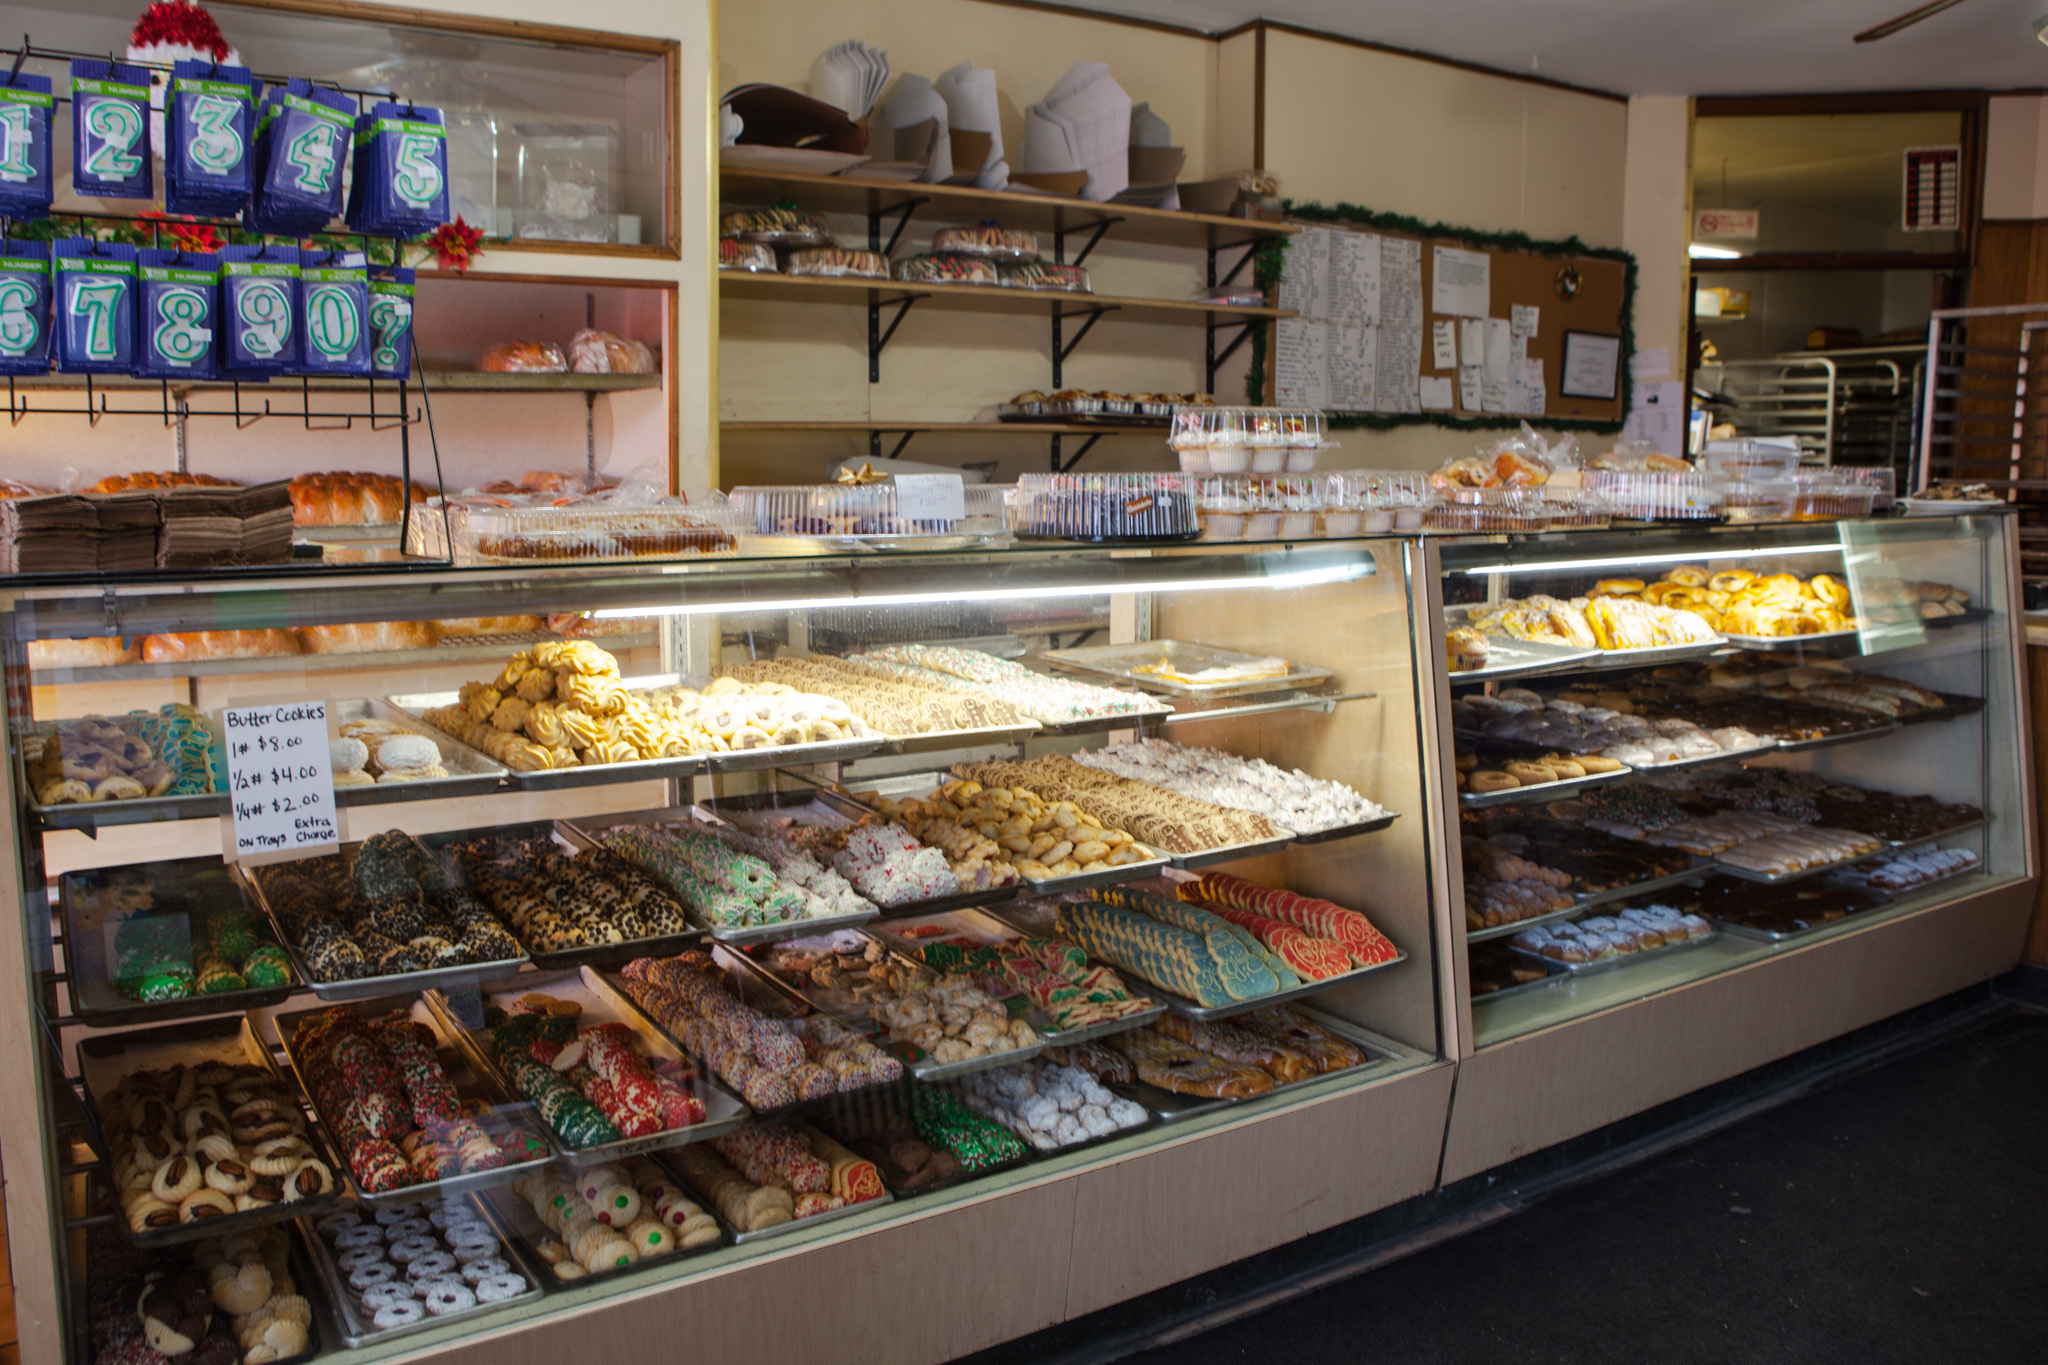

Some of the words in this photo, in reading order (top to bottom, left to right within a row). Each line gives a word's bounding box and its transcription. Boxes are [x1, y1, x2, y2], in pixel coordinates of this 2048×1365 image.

[7, 91, 47, 105] NUMBER
[107, 86, 147, 98] NUMBER
[208, 83, 246, 96] NUMBER
[316, 106, 351, 124] NUMBER
[85, 97, 143, 176] 2
[190, 95, 243, 172] 3
[408, 123, 442, 135] NUMBER
[0, 103, 36, 177] 1
[287, 122, 336, 192] 4
[394, 135, 443, 203] 5
[4, 259, 43, 270] NUMBER
[92, 262, 131, 272] NUMBER
[174, 272, 213, 282] NUMBER
[0, 278, 38, 352] 6
[70, 279, 125, 355] 7
[154, 289, 208, 362] 8
[238, 281, 292, 356] 9
[307, 286, 359, 356] 0
[227, 711, 273, 728] Butter
[275, 704, 326, 724] Cookies
[257, 735, 303, 752] $8.00
[271, 765, 318, 786] $4.00
[271, 793, 320, 813] $2.00
[294, 816, 332, 830] Extra
[256, 832, 287, 848] Trays
[296, 827, 337, 843] Charge
